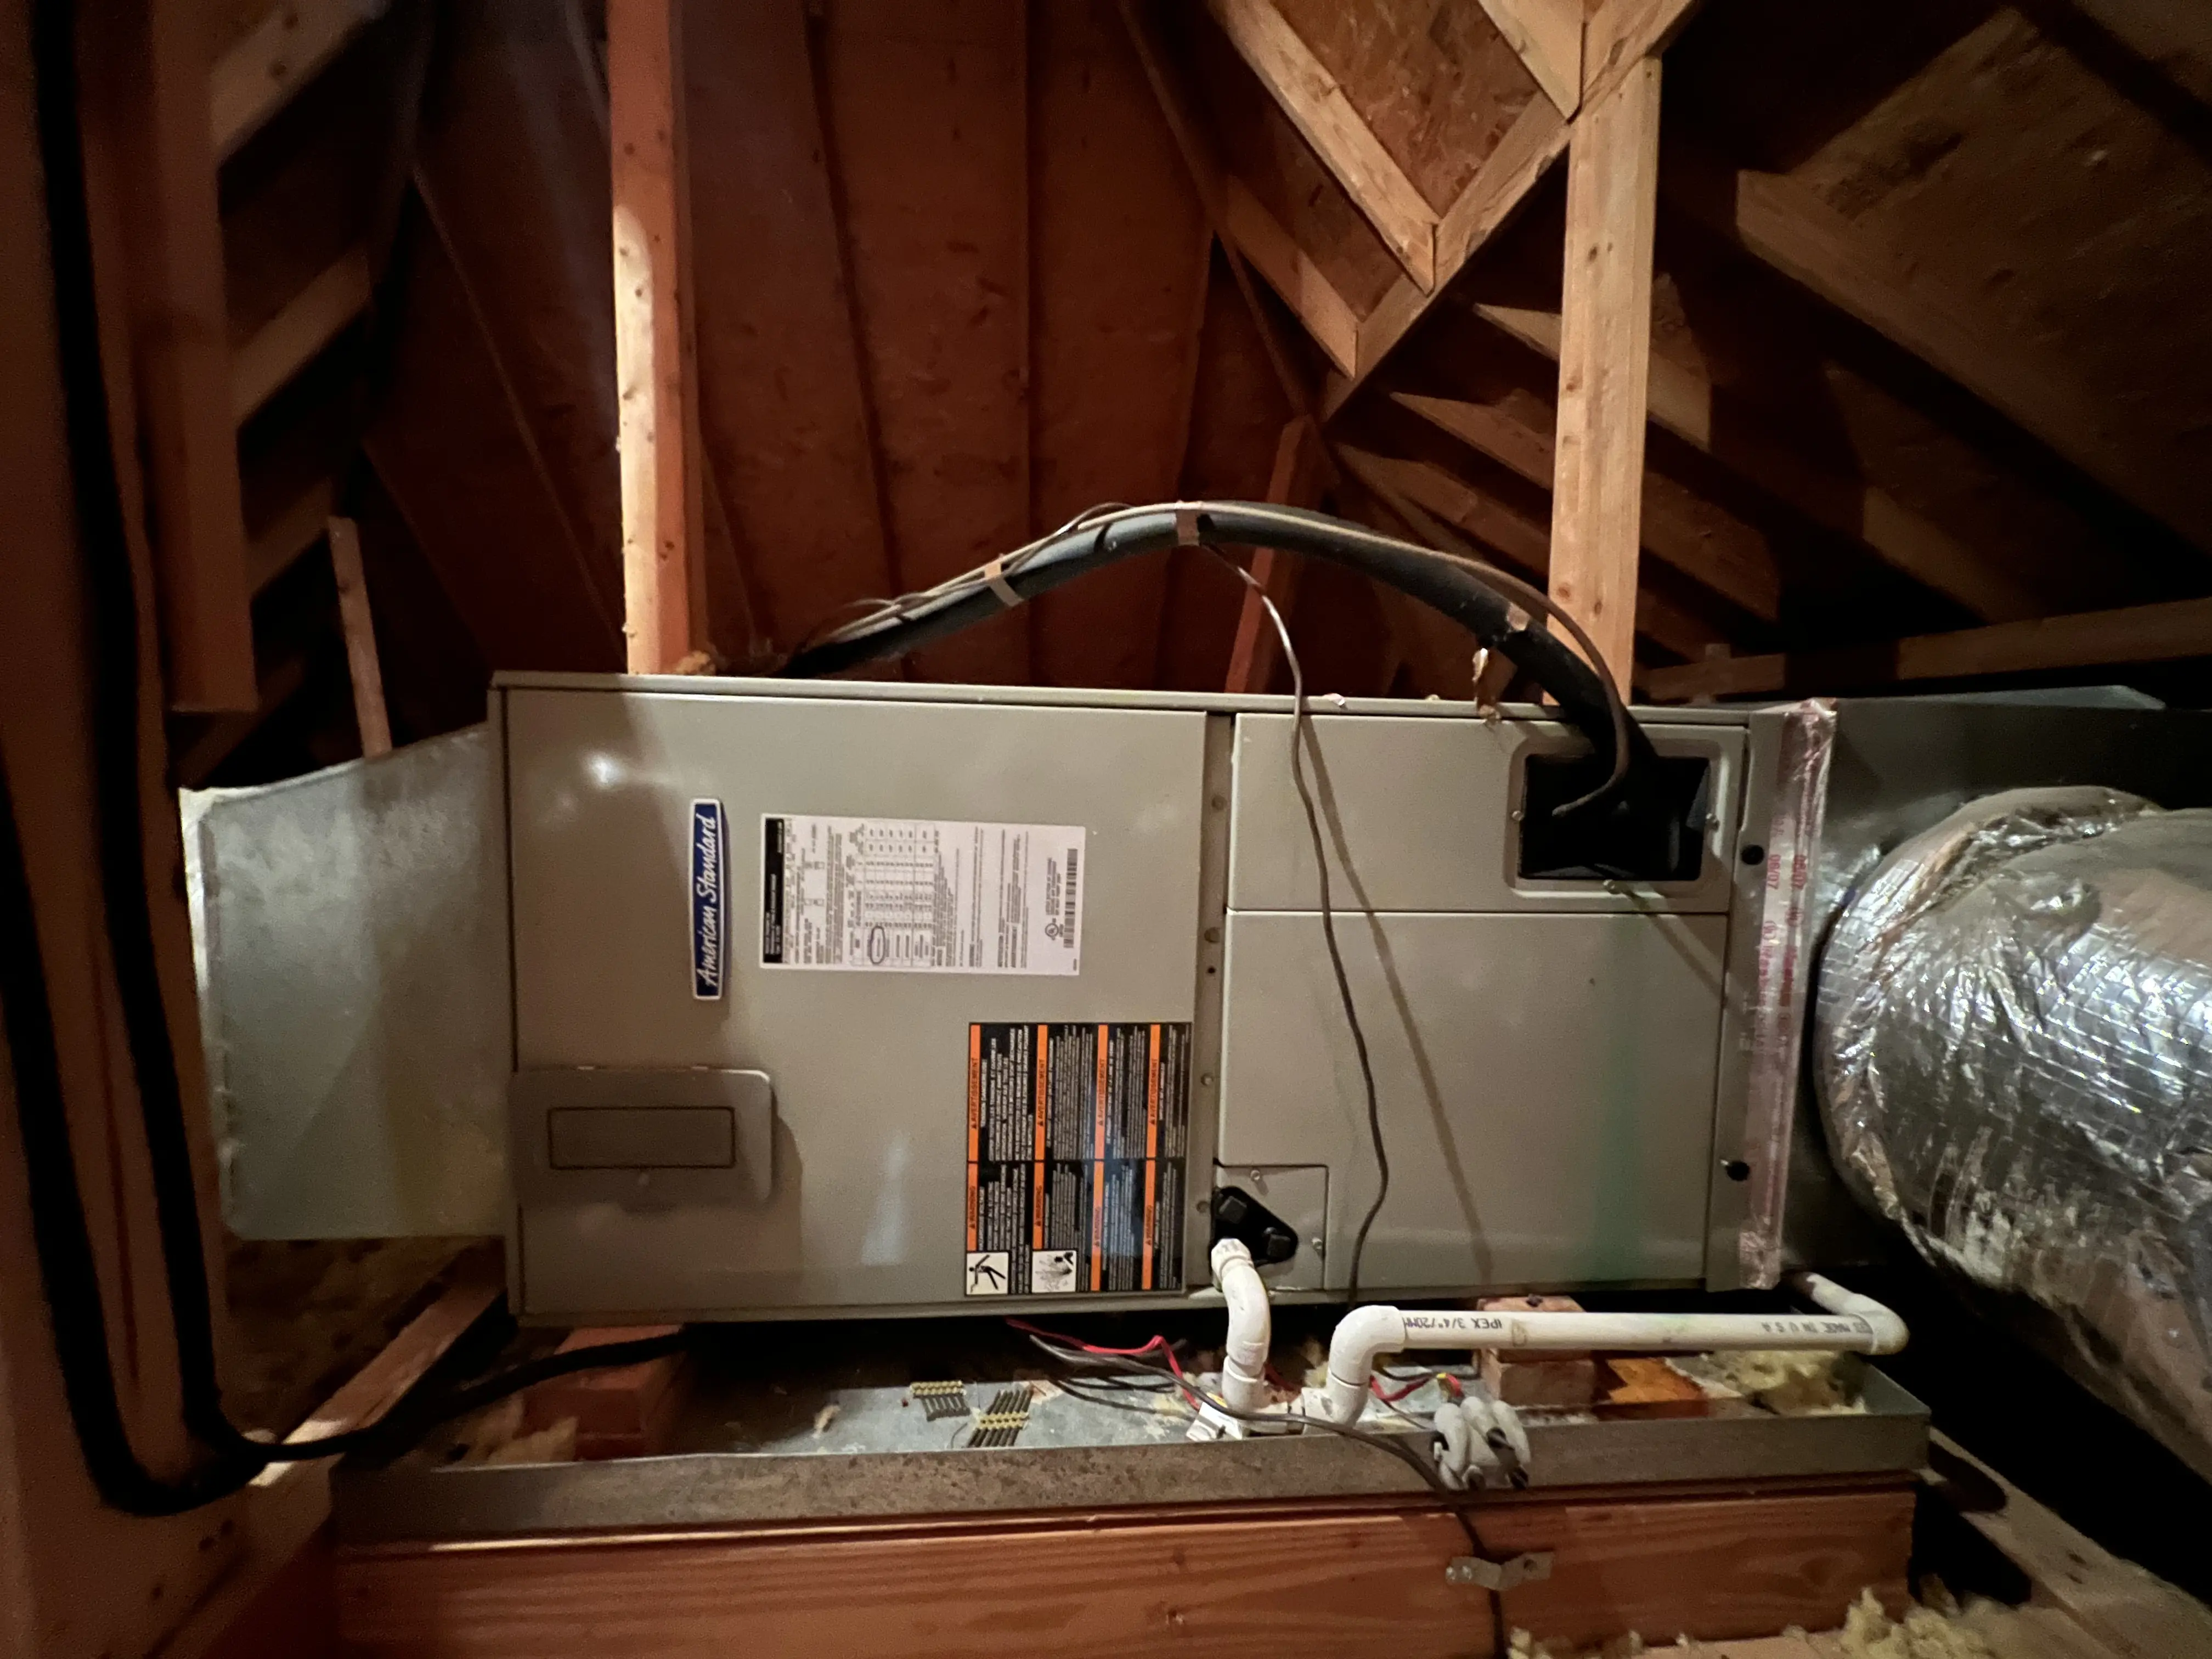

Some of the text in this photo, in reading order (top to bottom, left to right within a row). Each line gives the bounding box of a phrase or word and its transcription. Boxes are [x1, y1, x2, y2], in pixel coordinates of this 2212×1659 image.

[696, 813, 717, 987] American Standard
[1471, 1318, 1502, 1329] IPEX
